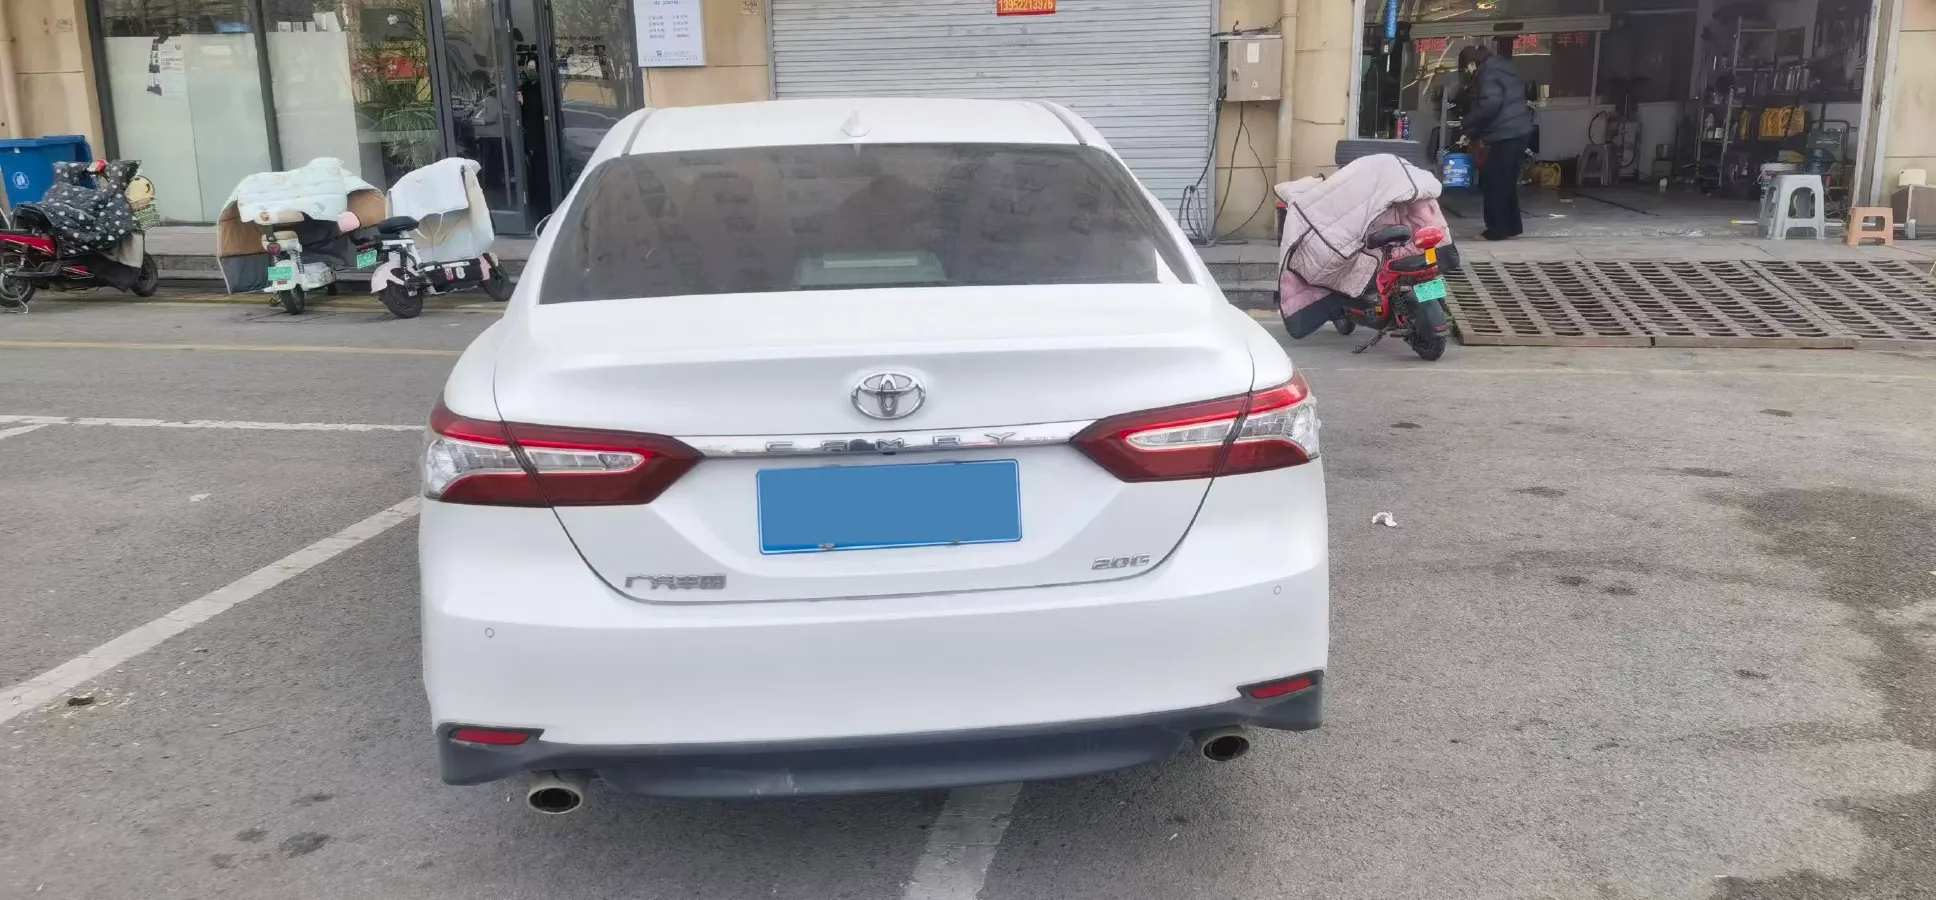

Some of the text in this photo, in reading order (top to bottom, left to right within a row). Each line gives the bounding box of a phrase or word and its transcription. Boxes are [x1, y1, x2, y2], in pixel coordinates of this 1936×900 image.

[765, 432, 1016, 452] CAMRY
[624, 573, 726, 591] 广汽丰田
